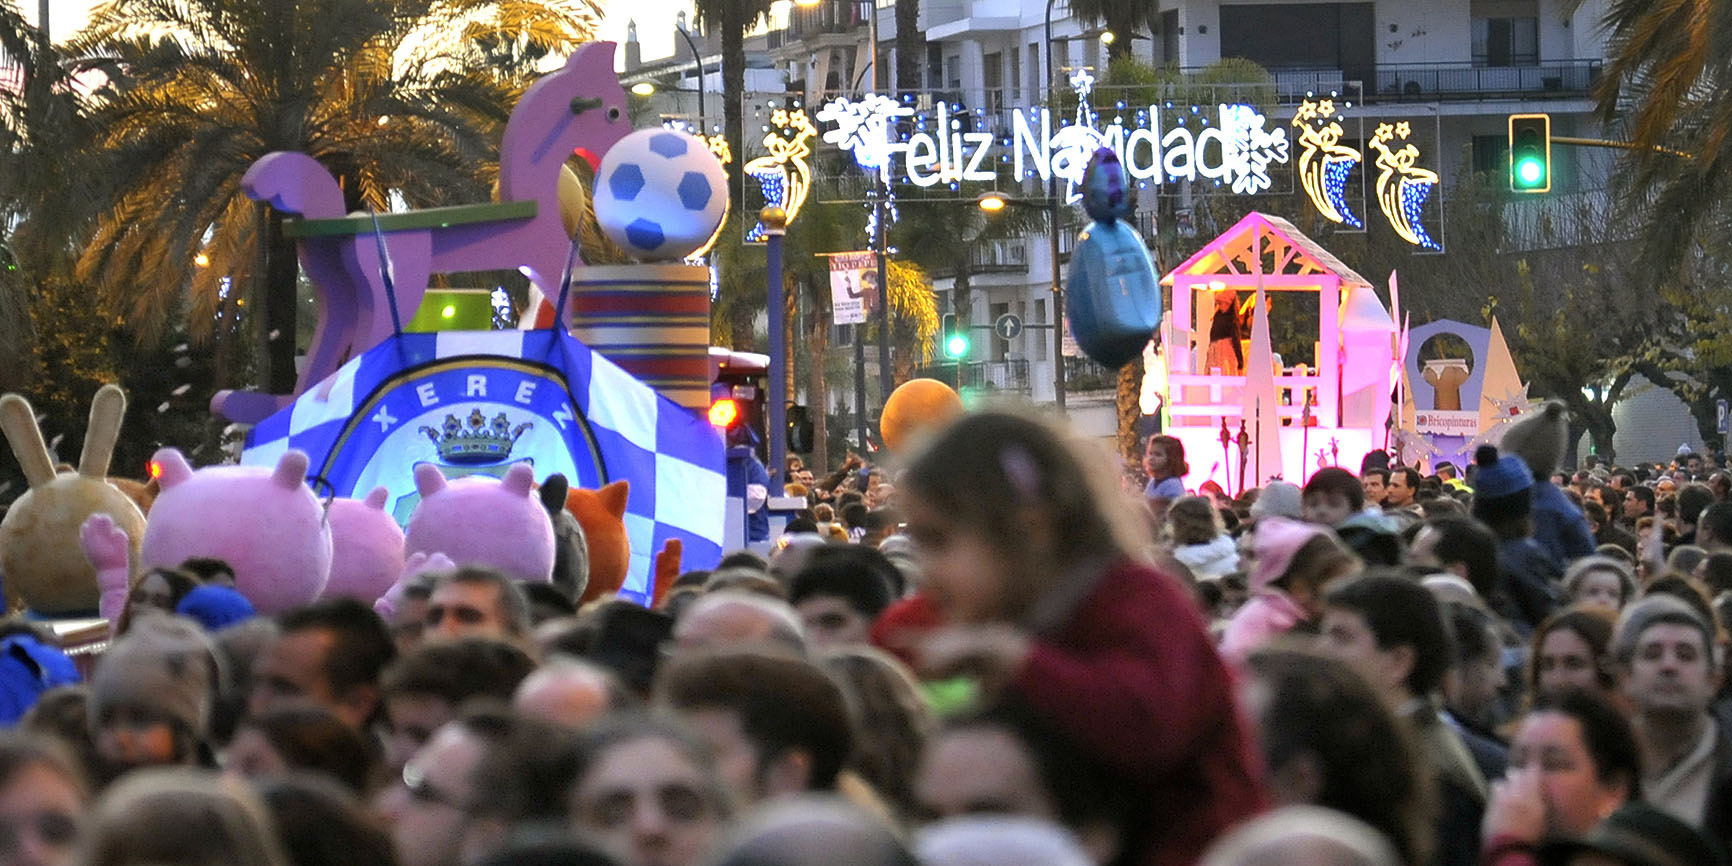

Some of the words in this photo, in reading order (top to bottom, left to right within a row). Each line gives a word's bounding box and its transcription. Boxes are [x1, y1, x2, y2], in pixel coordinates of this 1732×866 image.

[878, 100, 998, 187] Feliz
[372, 374, 574, 433] XEREZ
[1428, 414, 1477, 431] Bricopinturas
[1718, 405, 1725, 428] P
